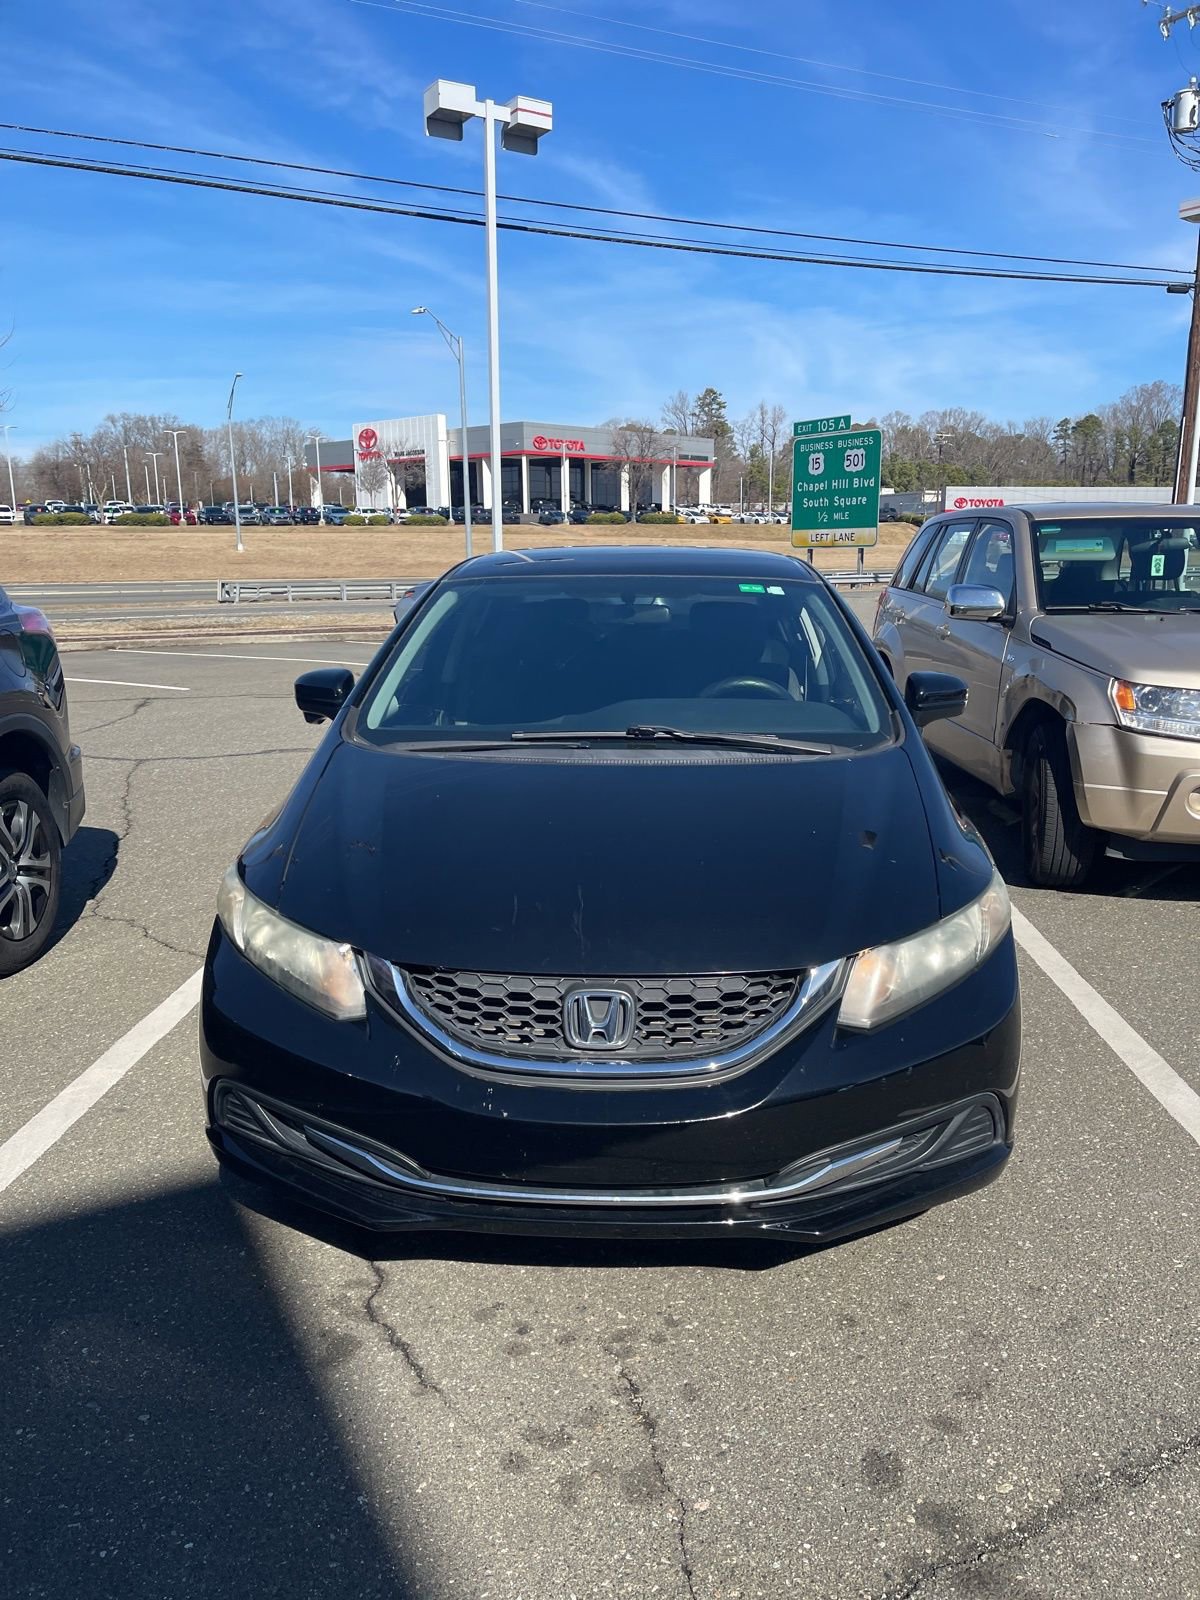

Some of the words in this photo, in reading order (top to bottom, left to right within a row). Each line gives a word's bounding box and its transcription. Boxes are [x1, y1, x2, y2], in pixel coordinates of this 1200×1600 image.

[797, 424, 812, 433] EXIT
[817, 419, 835, 432] 105
[838, 418, 846, 430] A
[800, 441, 834, 453] BUSINESS
[837, 436, 874, 449] BUSINESS
[811, 457, 821, 471] 15
[845, 453, 864, 468] 501
[797, 479, 828, 493] Chapel
[832, 478, 849, 490] Hill
[853, 476, 875, 488] Blvd
[802, 496, 829, 508] South
[833, 495, 867, 508] Square
[968, 499, 1005, 508] TOYOTA
[833, 511, 850, 521] MILE
[810, 533, 830, 543] LEFT
[833, 532, 856, 542] LANE
